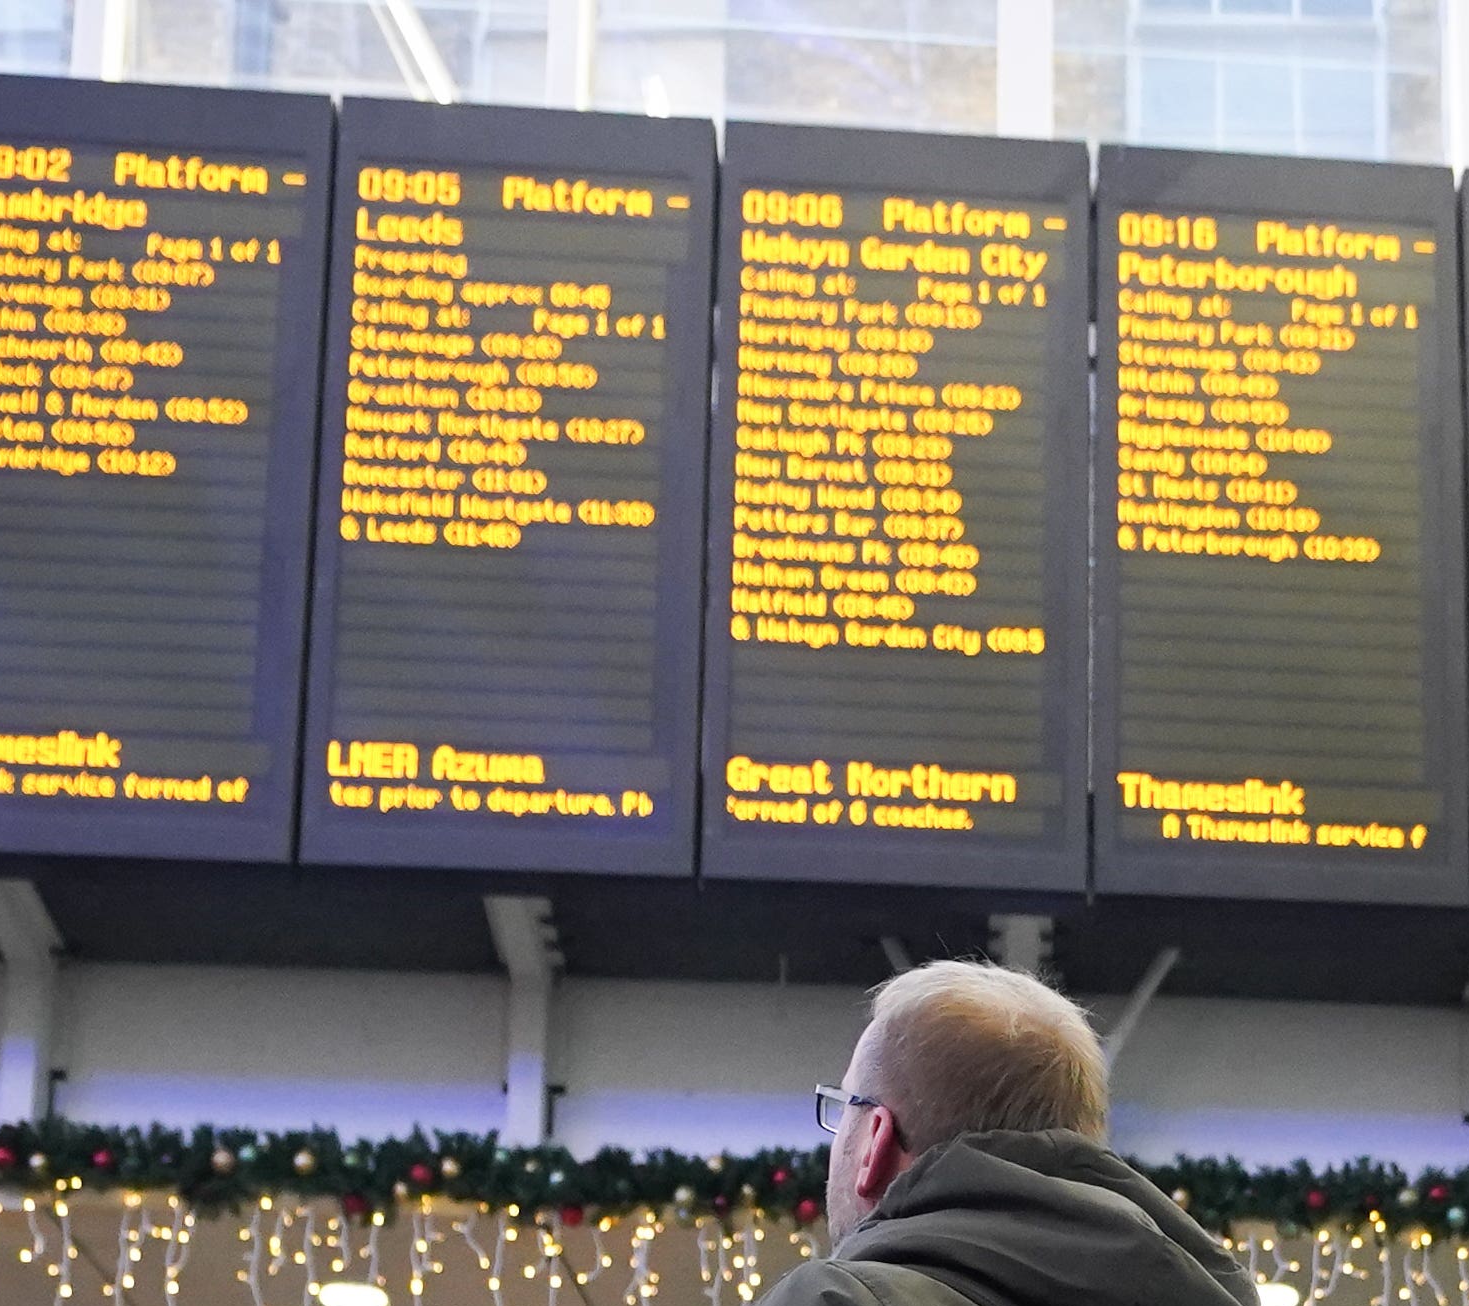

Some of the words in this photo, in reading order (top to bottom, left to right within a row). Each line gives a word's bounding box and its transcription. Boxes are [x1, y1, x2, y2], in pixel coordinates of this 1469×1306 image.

[114, 153, 268, 194] Platform
[358, 168, 461, 206] 09:05
[502, 176, 653, 216] Platform
[356, 209, 463, 246] Leeds
[742, 190, 843, 228] 09:06
[882, 198, 1031, 238] Platform
[1118, 213, 1218, 250] 09:16
[1256, 221, 1400, 261] Platform
[741, 230, 851, 269] Welwyn
[859, 237, 971, 274] Garden
[979, 243, 1047, 280] City
[1118, 251, 1358, 300] Peterborough
[327, 741, 419, 778] LNER
[431, 745, 545, 784] Azuma
[726, 756, 833, 794] Great
[846, 762, 1017, 802] Northern
[1117, 772, 1305, 815] Thameslink
